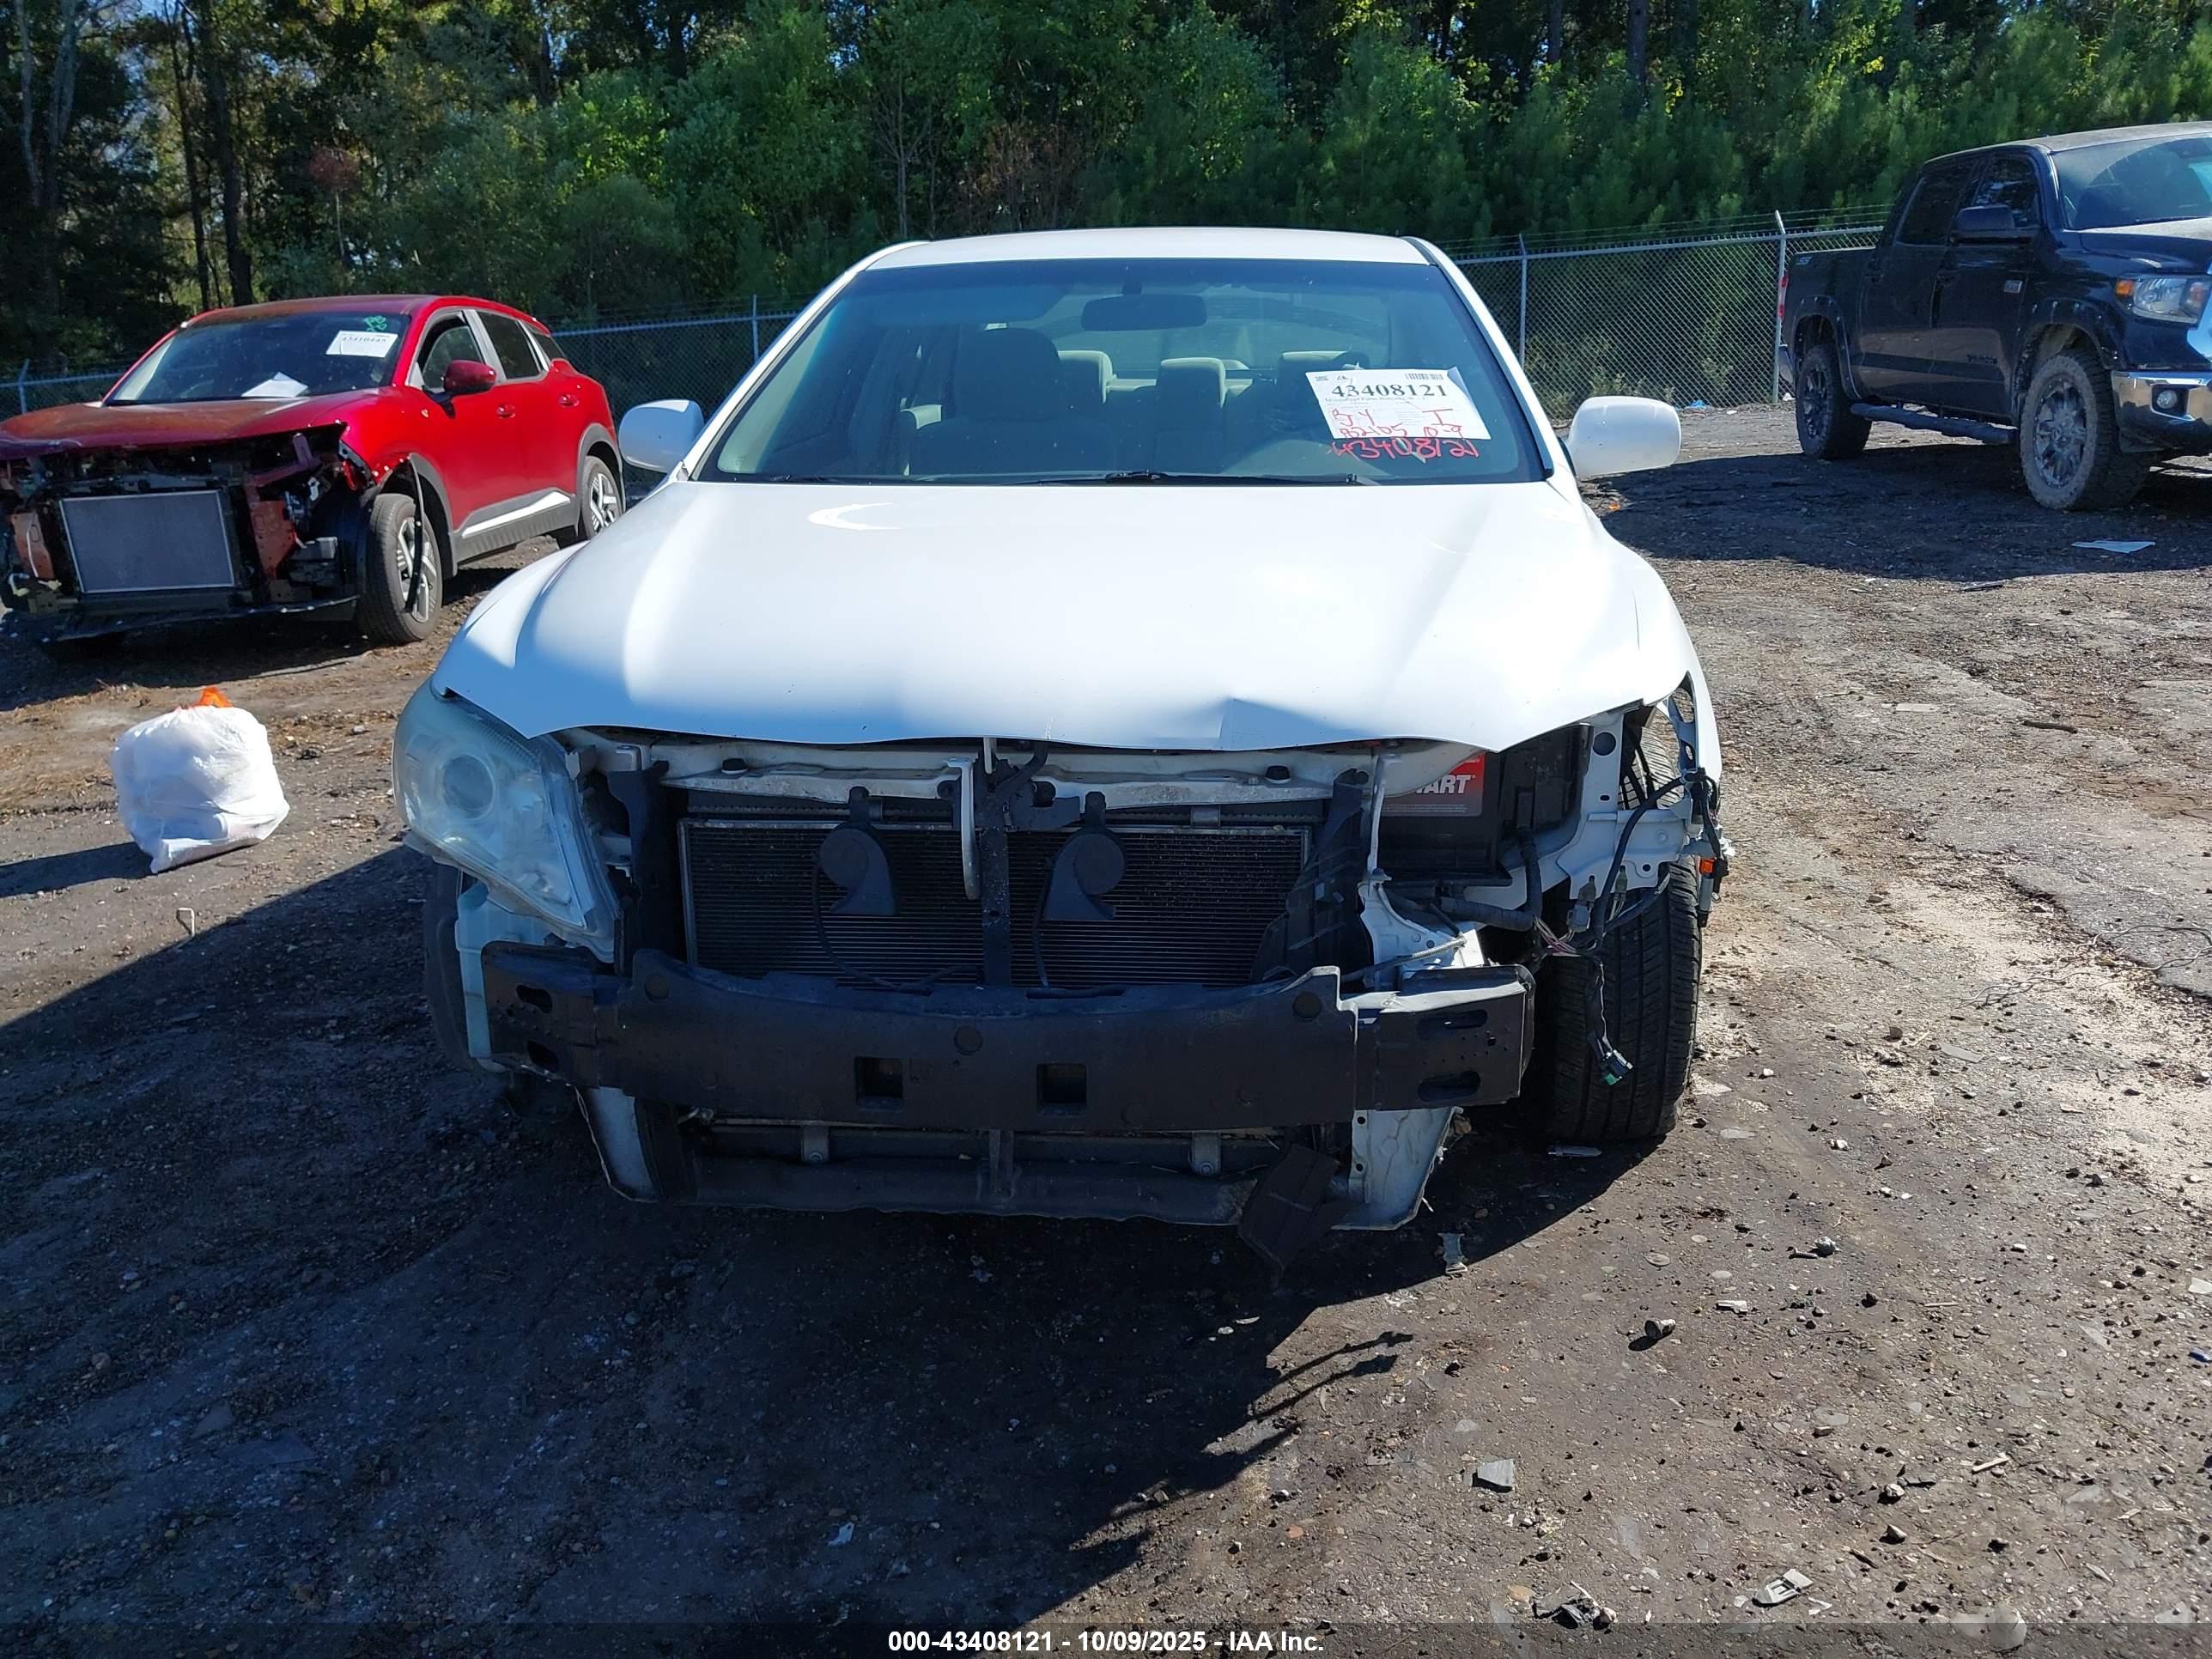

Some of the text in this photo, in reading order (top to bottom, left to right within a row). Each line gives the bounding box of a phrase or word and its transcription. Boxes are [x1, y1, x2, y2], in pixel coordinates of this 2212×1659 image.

[1331, 384, 1448, 398] 43408121
[1329, 437, 1479, 459] 43408121
[1416, 775, 1471, 793] ART
